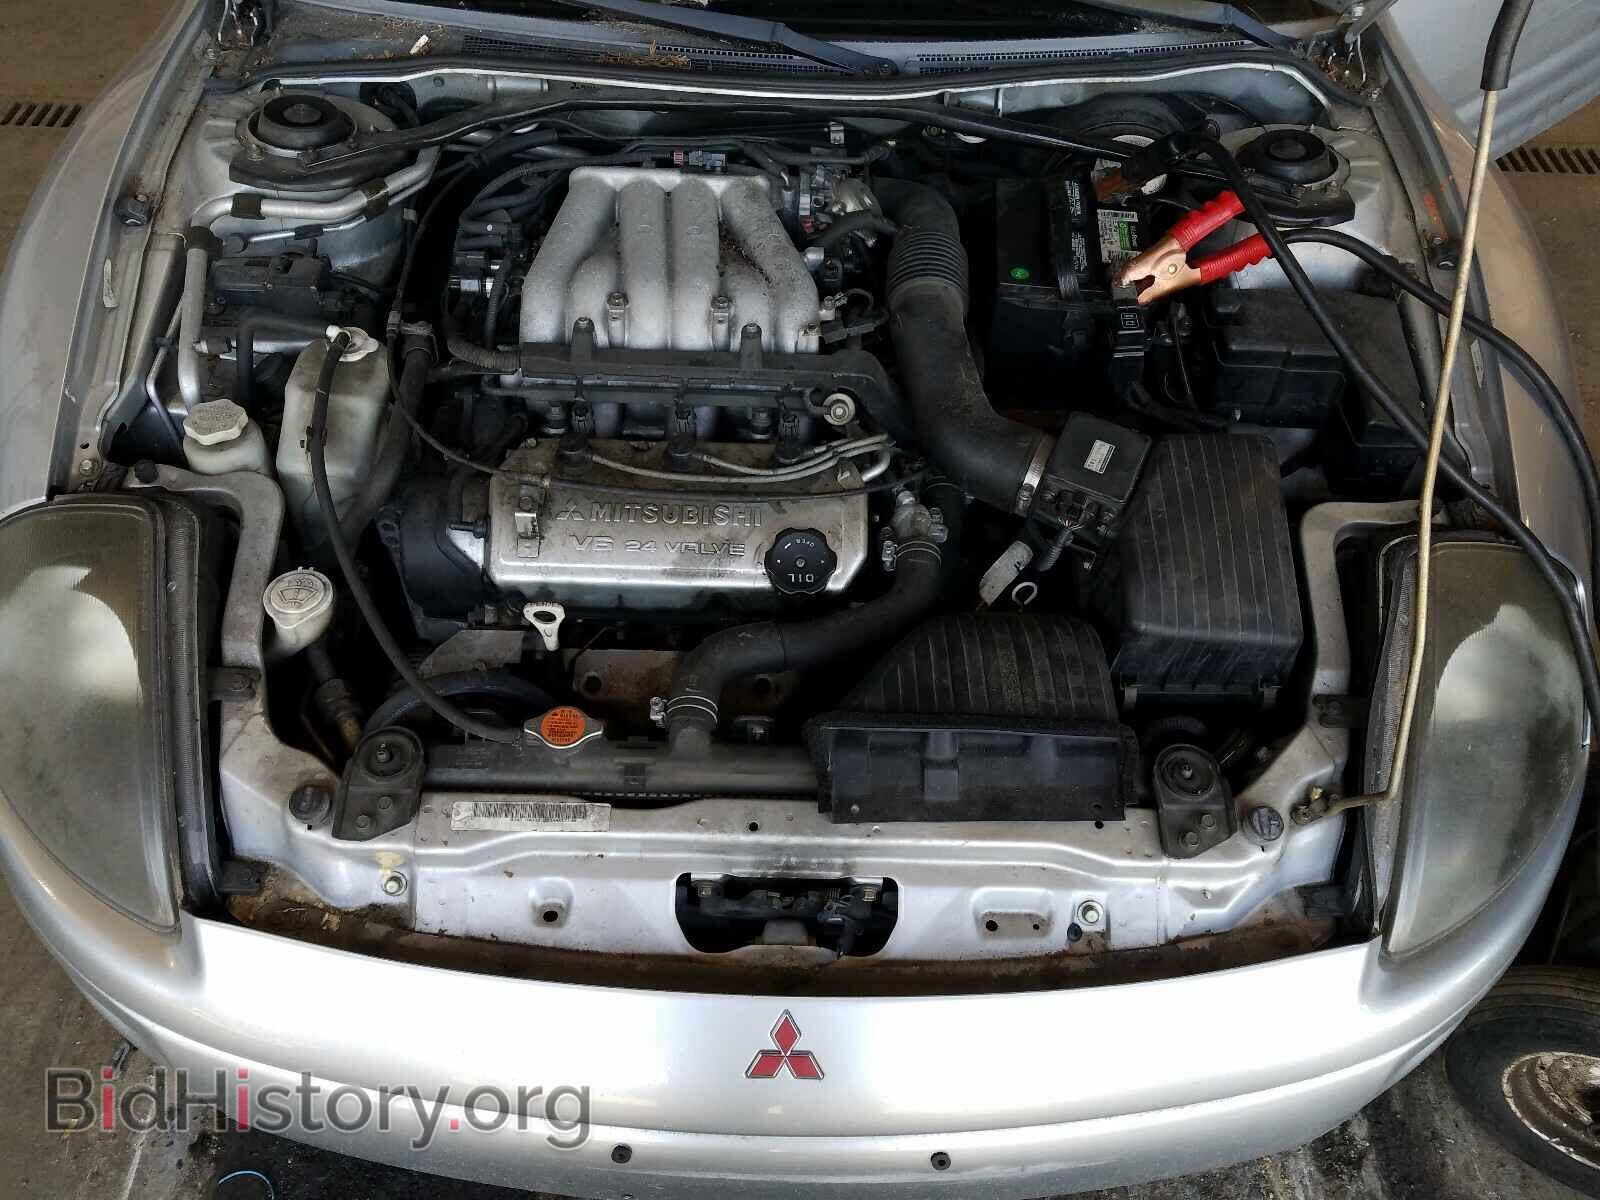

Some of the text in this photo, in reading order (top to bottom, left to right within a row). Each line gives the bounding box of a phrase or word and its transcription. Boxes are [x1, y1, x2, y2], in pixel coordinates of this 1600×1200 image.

[591, 502, 762, 527] MITSUBISHI
[570, 535, 745, 557] V6 24 VALVE
[786, 573, 815, 583] OIL
